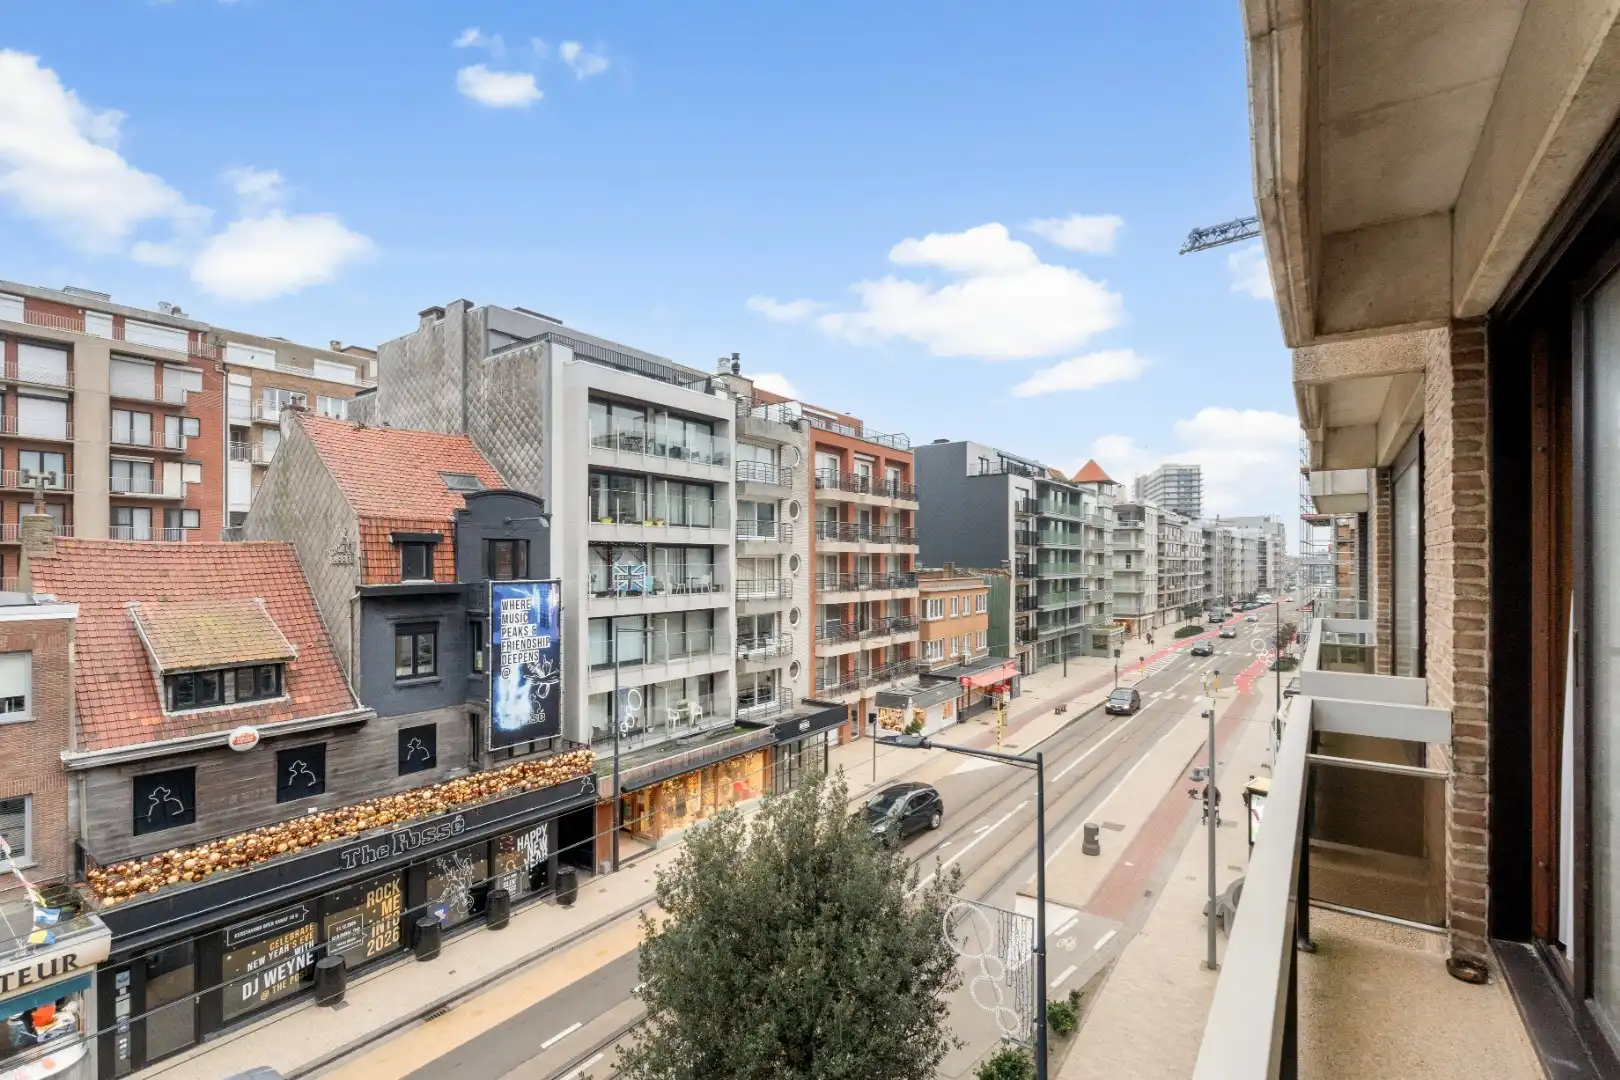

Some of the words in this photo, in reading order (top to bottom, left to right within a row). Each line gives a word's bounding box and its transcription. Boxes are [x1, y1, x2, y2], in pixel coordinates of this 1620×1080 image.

[502, 599, 531, 610] WHERE
[502, 613, 528, 624] MUSIC
[502, 626, 528, 637] PEAKS
[532, 625, 536, 636] &
[502, 636, 550, 651] FRIENDSHIP
[502, 651, 539, 665] DEEPENS
[502, 667, 510, 679] @
[517, 823, 548, 852] HAPPY
[527, 834, 548, 862] NEW
[341, 845, 390, 870] The
[366, 878, 400, 908] ROCK
[381, 894, 400, 917] ME
[269, 922, 315, 951] CELEBRATE
[371, 910, 400, 938] INTO
[247, 955, 266, 972] NEW
[300, 931, 315, 945] EVE
[294, 940, 315, 956] WITH
[367, 926, 400, 957] 2026
[0, 954, 79, 992] TEUR
[242, 977, 259, 1001] DJ
[263, 952, 315, 988] WEYNE
[260, 989, 270, 1001] @
[272, 979, 287, 994] THE
